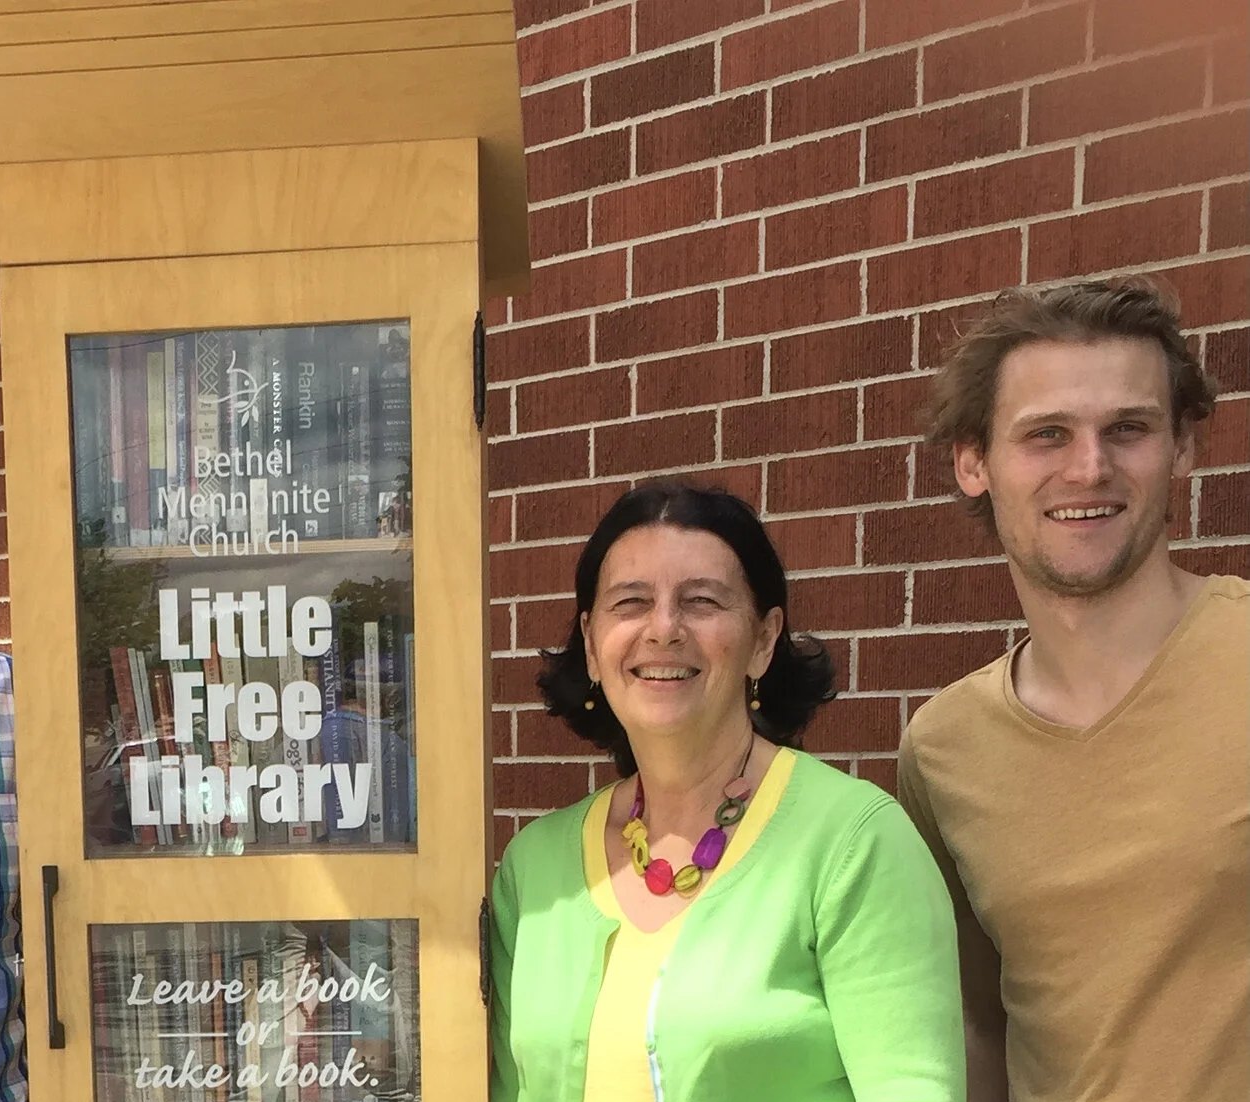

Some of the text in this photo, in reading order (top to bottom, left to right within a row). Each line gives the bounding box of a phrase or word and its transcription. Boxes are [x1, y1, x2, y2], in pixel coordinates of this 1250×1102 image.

[272, 371, 282, 434] MONSTER
[298, 361, 316, 430] Rankin
[194, 439, 292, 478] Bethel
[189, 520, 299, 557] Church
[158, 585, 332, 661] Little
[172, 671, 322, 743] Free
[286, 739, 302, 766] og's
[129, 755, 372, 829] Library
[127, 962, 391, 1005] Leave a book
[236, 1021, 280, 1046] or
[134, 1047, 379, 1089] take a book.
